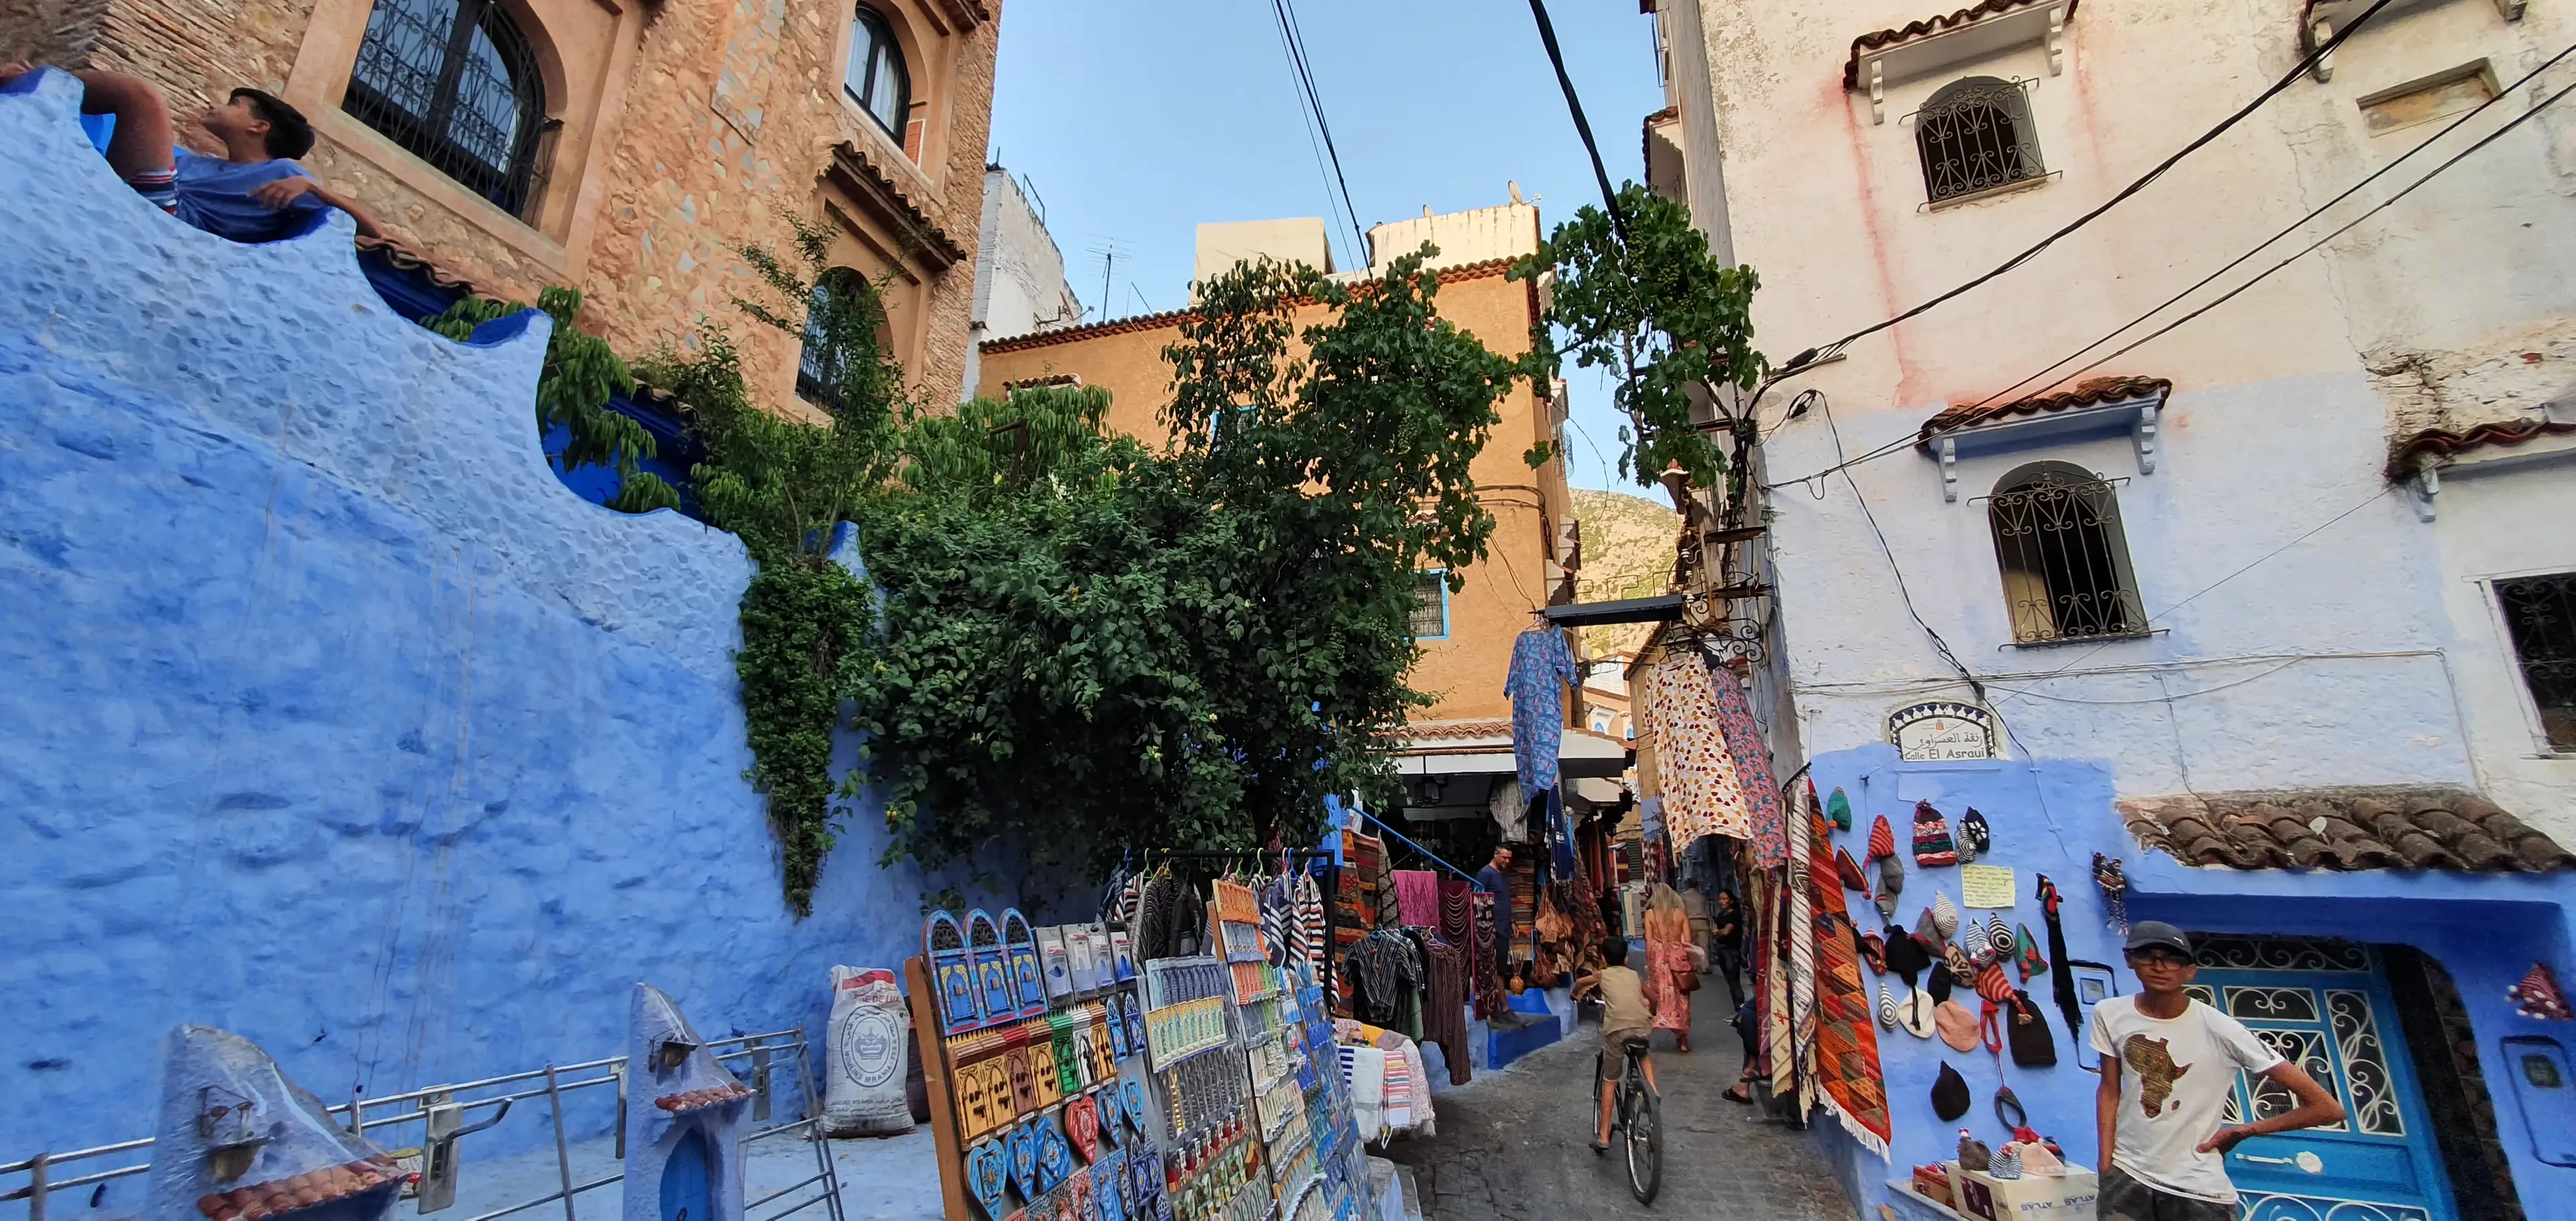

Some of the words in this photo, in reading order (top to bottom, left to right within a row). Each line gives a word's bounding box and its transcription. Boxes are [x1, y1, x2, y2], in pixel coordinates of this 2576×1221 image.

[1964, 731, 1983, 747] زنقة
[1904, 751, 1925, 760] Calle
[1929, 749, 1940, 759] El
[1946, 747, 1985, 759] Asraui
[872, 995, 884, 1003] DE
[844, 1050, 864, 1080] MOULINS
[2020, 1200, 2053, 1212] ATLAS
[2063, 1193, 2096, 1206] ATLAS
